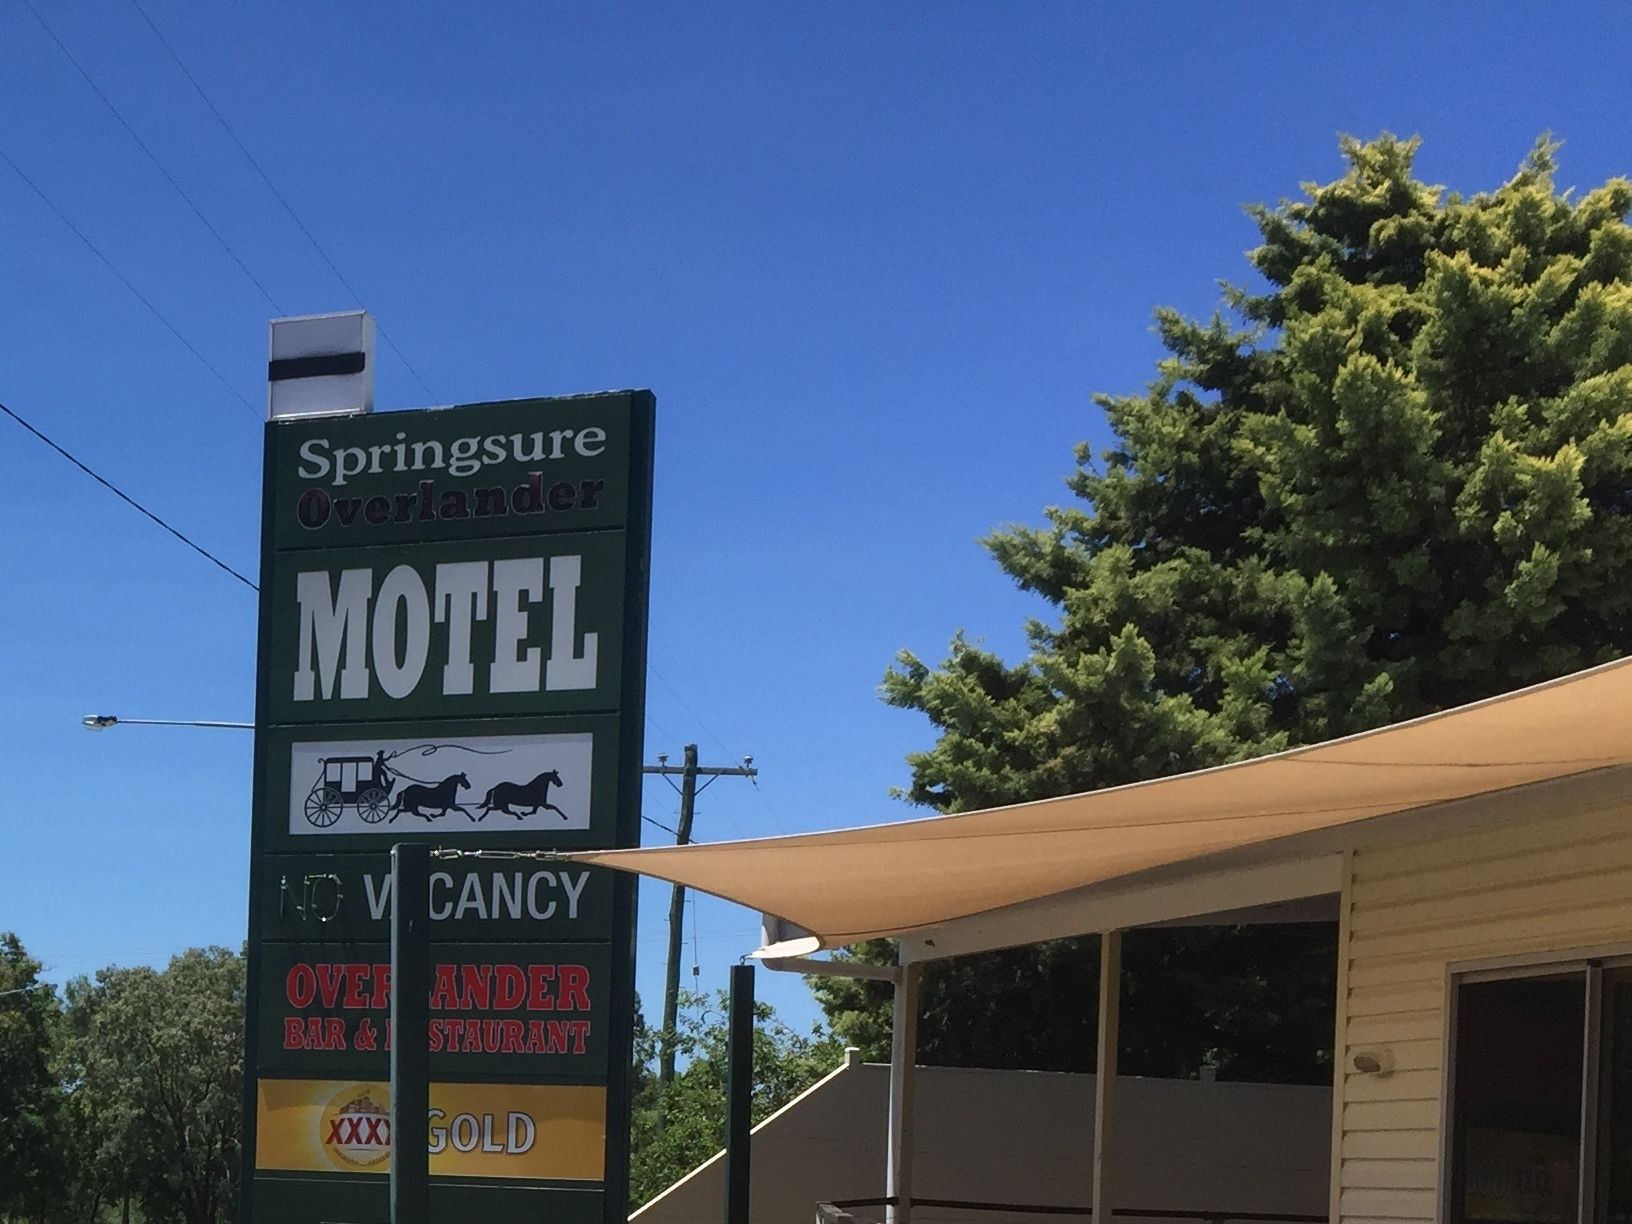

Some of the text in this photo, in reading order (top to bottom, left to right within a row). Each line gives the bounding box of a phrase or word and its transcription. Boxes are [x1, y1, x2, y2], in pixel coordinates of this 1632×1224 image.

[297, 426, 606, 486] Springsure
[296, 471, 604, 530] Overlander
[293, 555, 598, 701] MOTEL
[279, 871, 590, 922] NO VCANCY
[286, 963, 591, 1011] OVERANDER
[283, 1016, 591, 1054] BAR & STAURANT
[428, 1108, 535, 1155] GOLD
